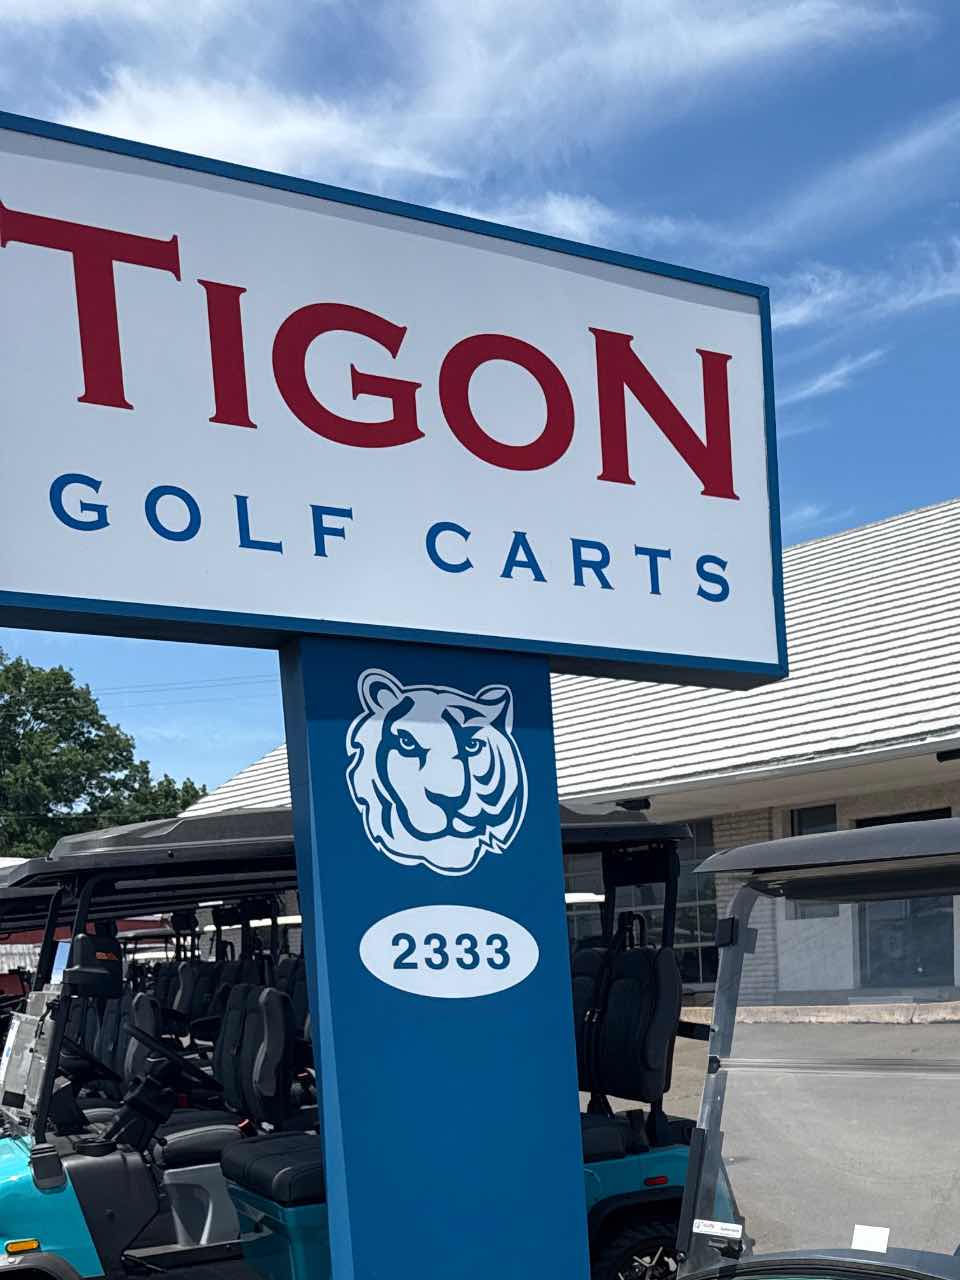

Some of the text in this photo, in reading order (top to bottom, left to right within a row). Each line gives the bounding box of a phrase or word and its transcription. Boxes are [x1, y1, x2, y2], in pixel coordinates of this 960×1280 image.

[0, 201, 740, 500] TIGON
[48, 472, 732, 603] GOLF CARTS
[391, 932, 511, 970] 2333
